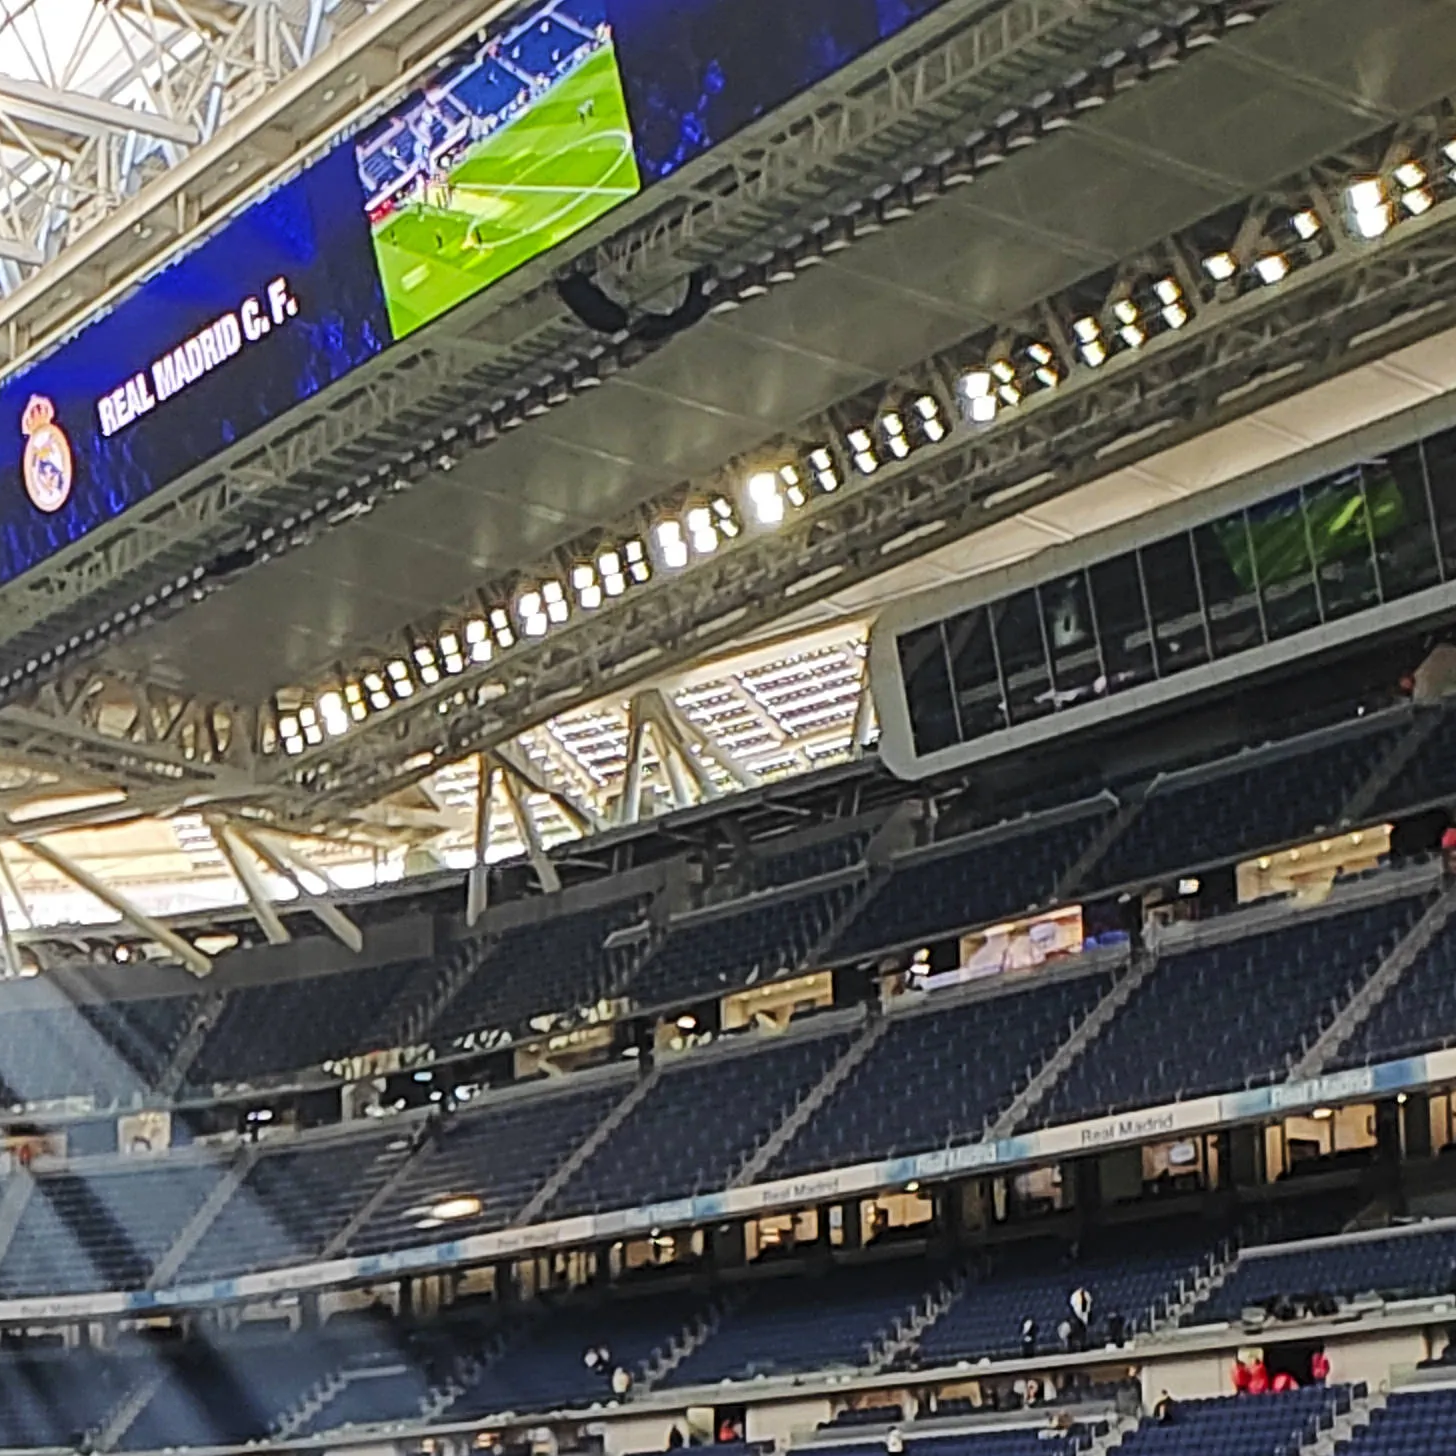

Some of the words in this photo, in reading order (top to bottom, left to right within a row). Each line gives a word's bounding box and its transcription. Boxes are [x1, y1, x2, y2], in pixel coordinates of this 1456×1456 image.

[97, 373, 156, 437] REAL
[152, 313, 242, 401] MADRID
[1081, 1124, 1114, 1145] Real
[1119, 1113, 1173, 1135] Madrid
